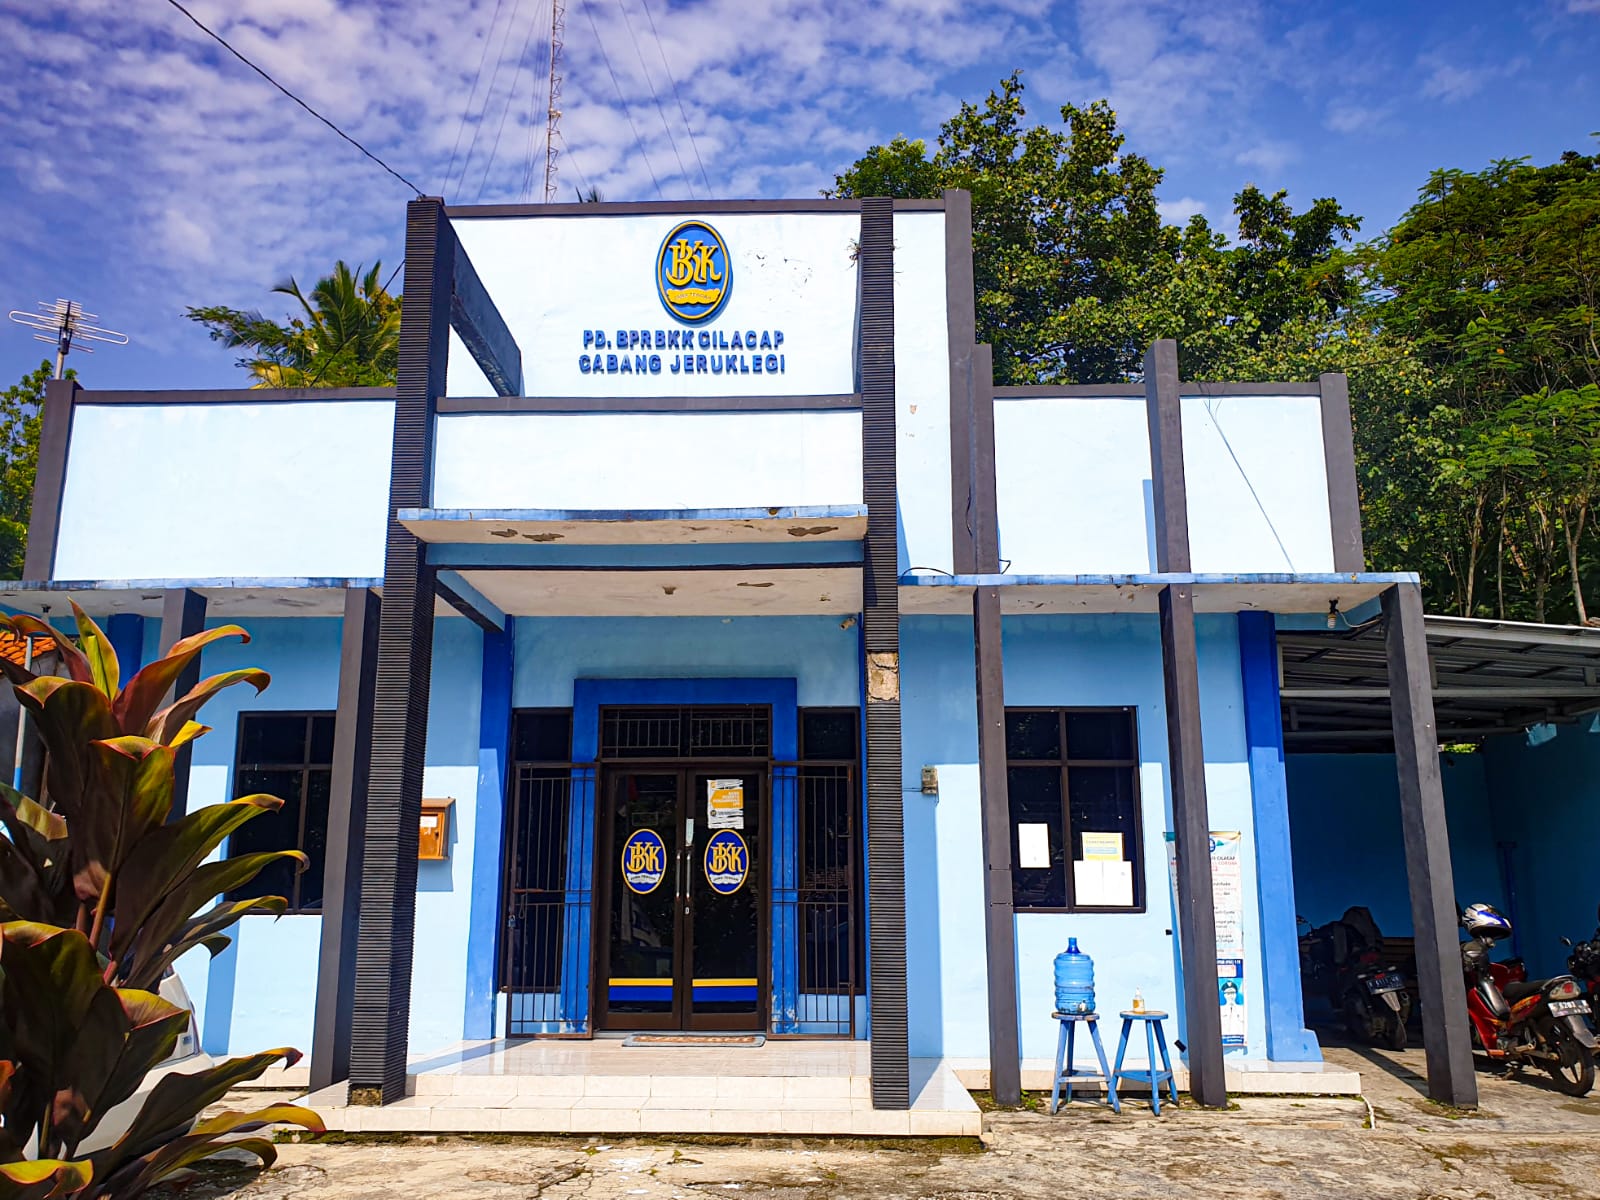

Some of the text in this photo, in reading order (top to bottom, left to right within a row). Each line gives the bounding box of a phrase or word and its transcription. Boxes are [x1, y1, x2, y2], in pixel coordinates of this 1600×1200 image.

[583, 330, 611, 350] PD.
[698, 330, 784, 350] CILACAP
[579, 354, 785, 375] CABANG JERUKLEGI
